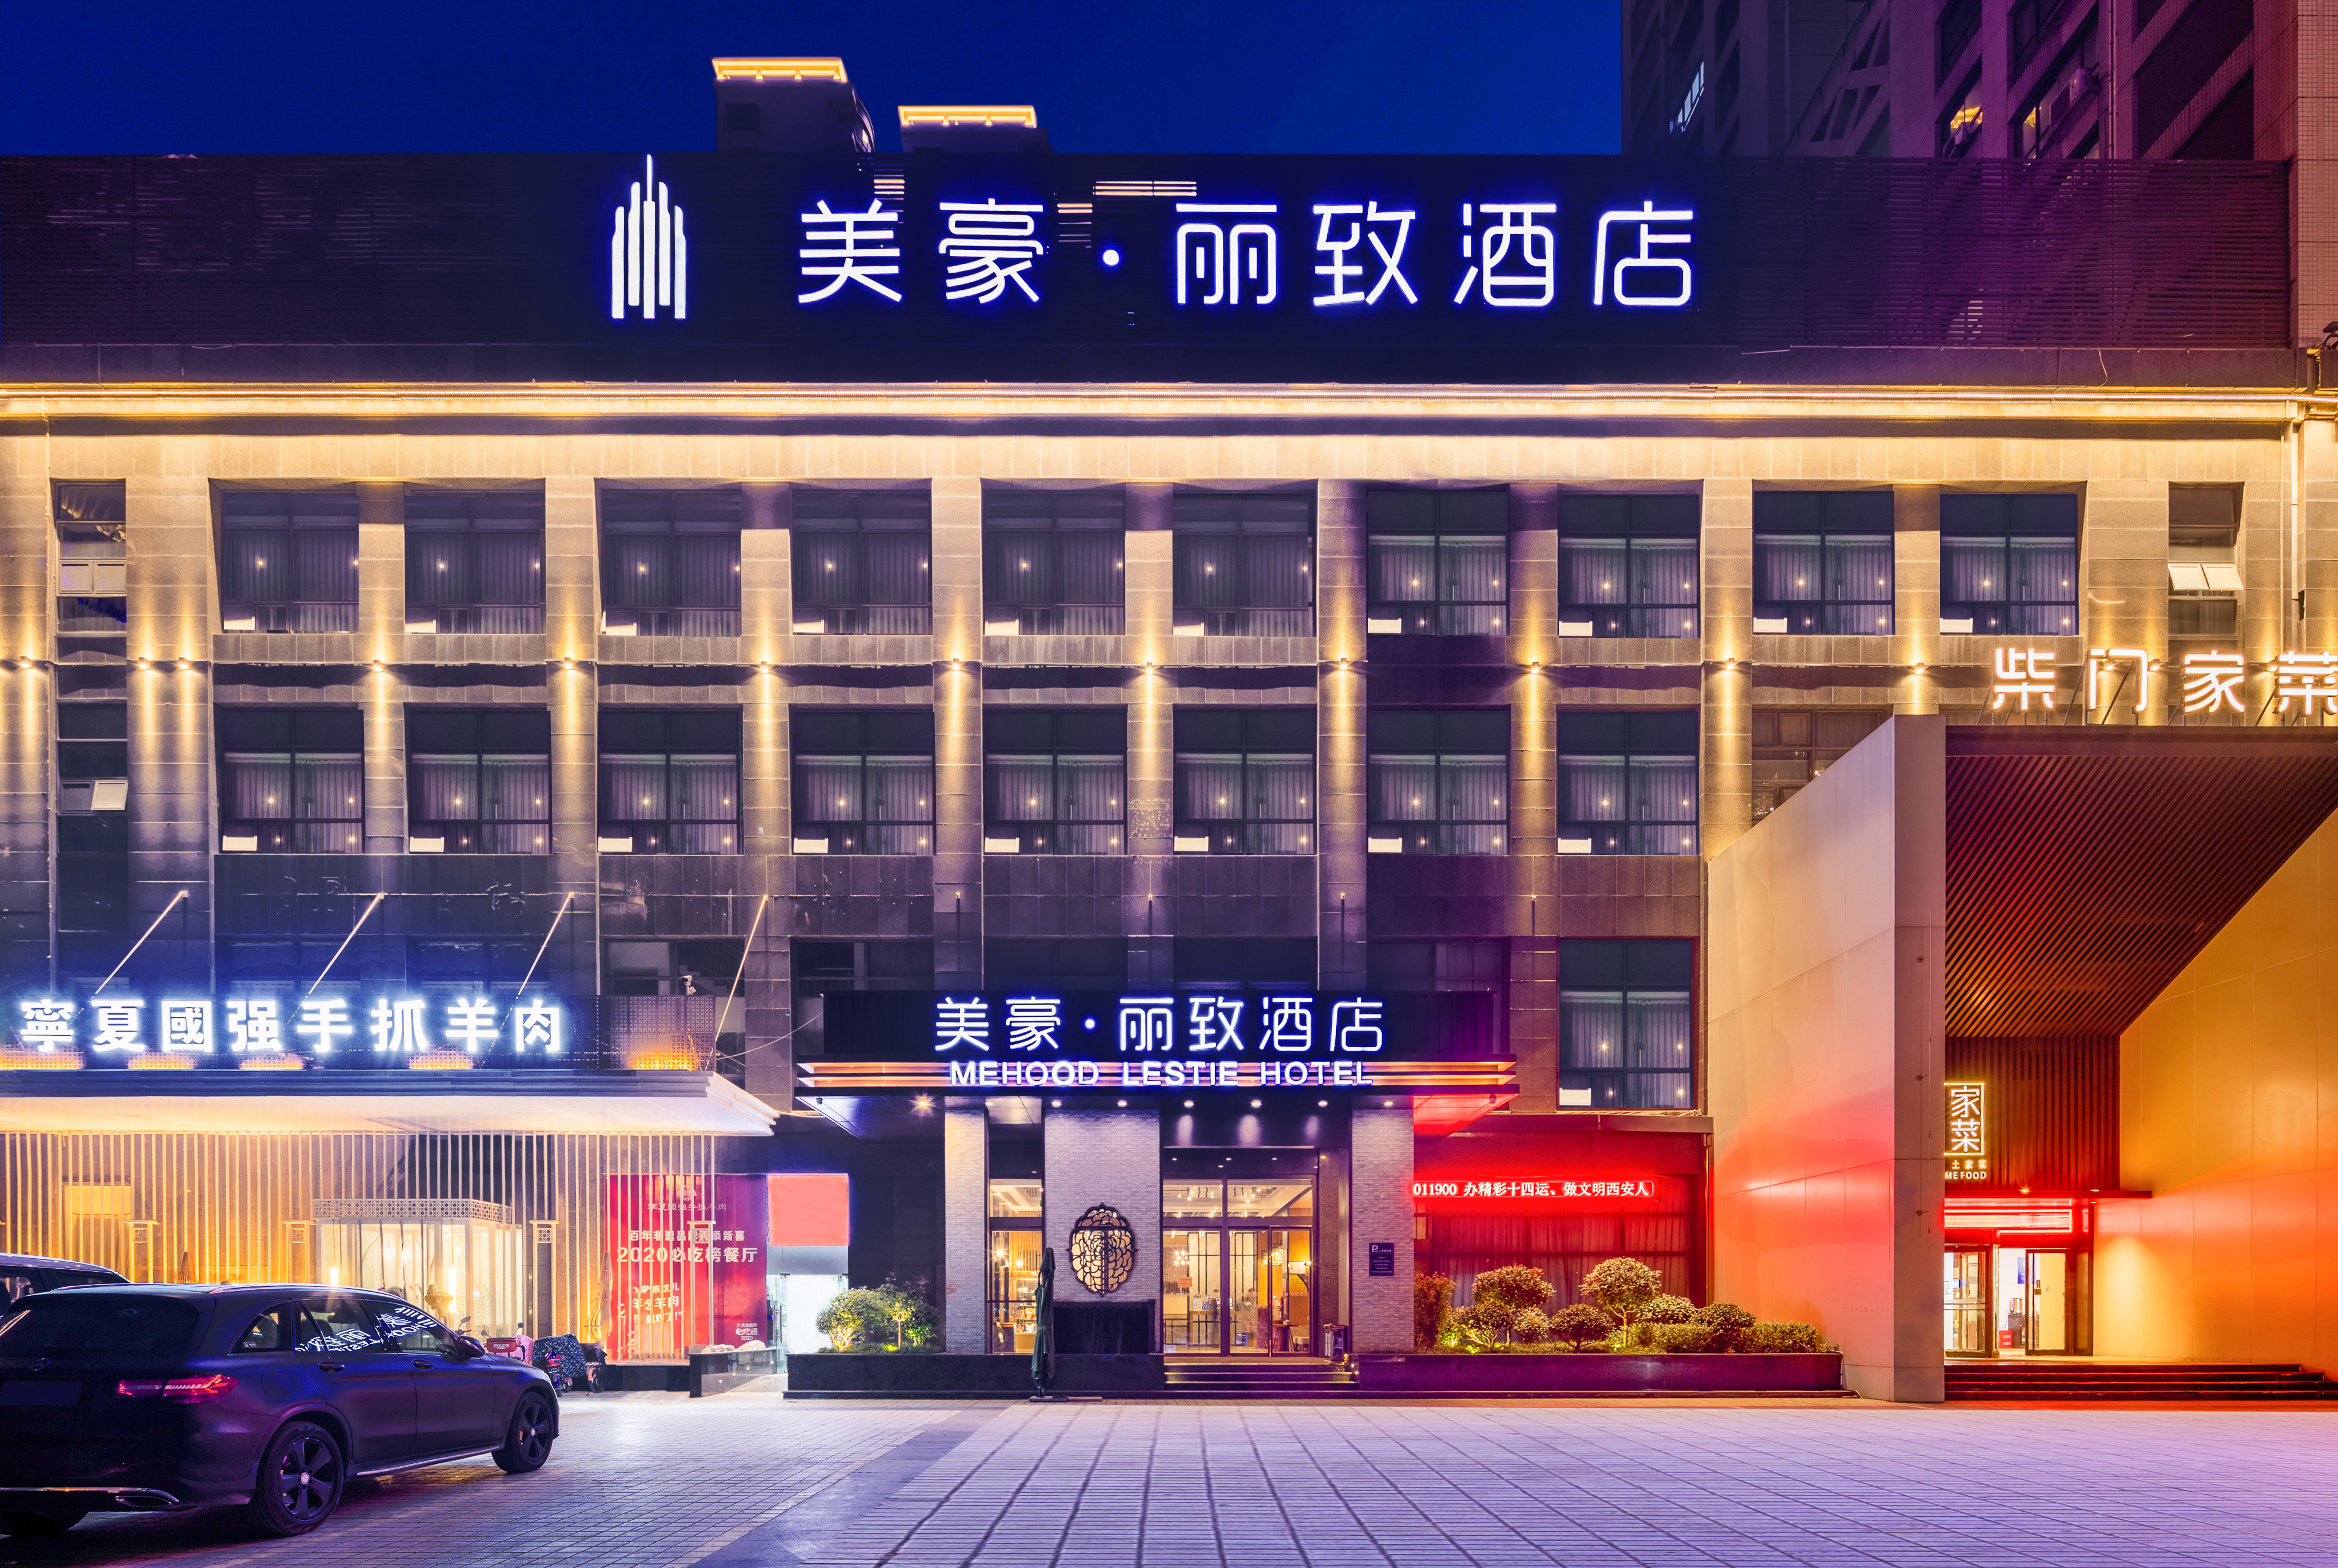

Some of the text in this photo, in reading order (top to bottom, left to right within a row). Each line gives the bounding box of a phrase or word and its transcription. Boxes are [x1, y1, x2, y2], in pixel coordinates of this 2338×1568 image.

[798, 198, 1694, 307] 美豪·丽致酒店
[1993, 648, 2338, 715] 柴门家菜
[935, 997, 1383, 1051] 美豪·丽致酒店
[951, 1061, 1373, 1086] MEHOOD LESTIE HOTEL
[1951, 1085, 1980, 1152] 家菜
[1413, 1181, 1649, 1197] 011900 办精彩十四运、做文明西安人
[1960, 1171, 1987, 1179] FOOD
